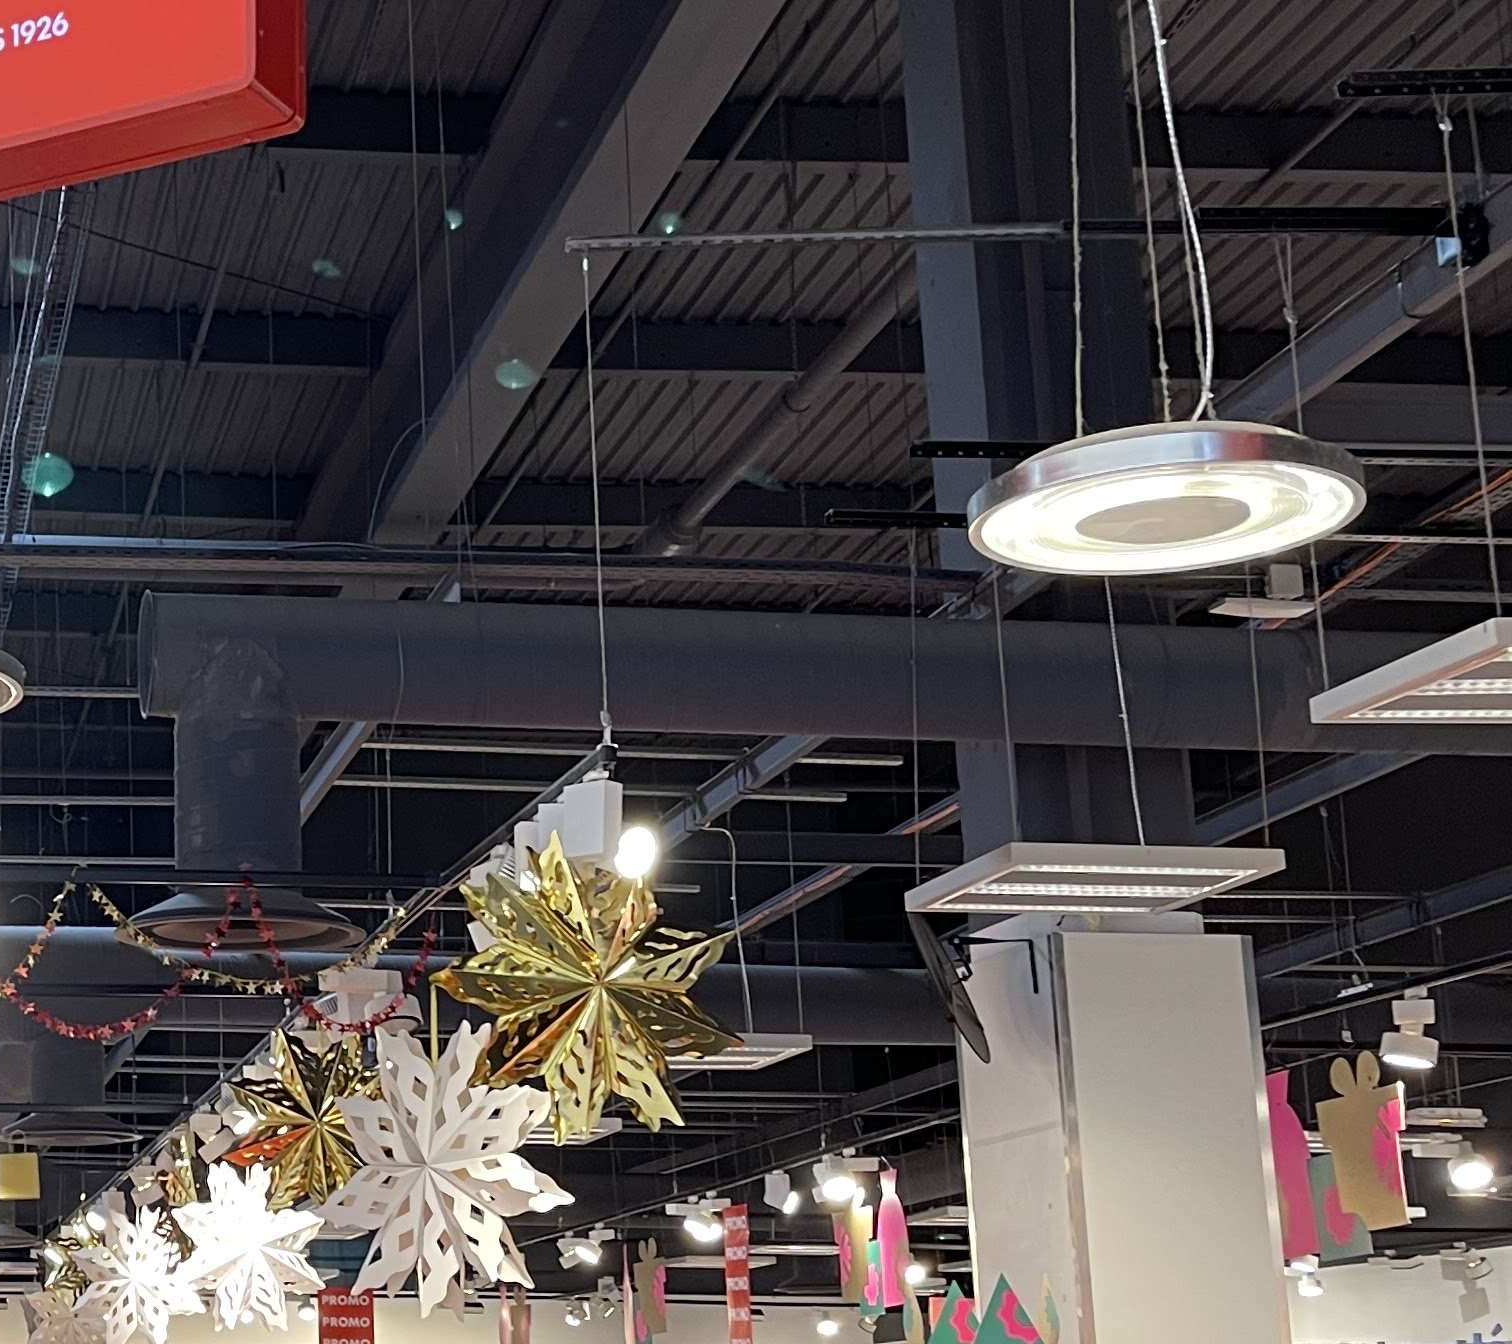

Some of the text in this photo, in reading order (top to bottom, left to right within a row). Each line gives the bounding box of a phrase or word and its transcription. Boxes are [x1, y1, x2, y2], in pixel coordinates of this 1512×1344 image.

[11, 11, 70, 47] 1926
[321, 1295, 370, 1306] PROMO
[322, 1317, 371, 1327] PROMO
